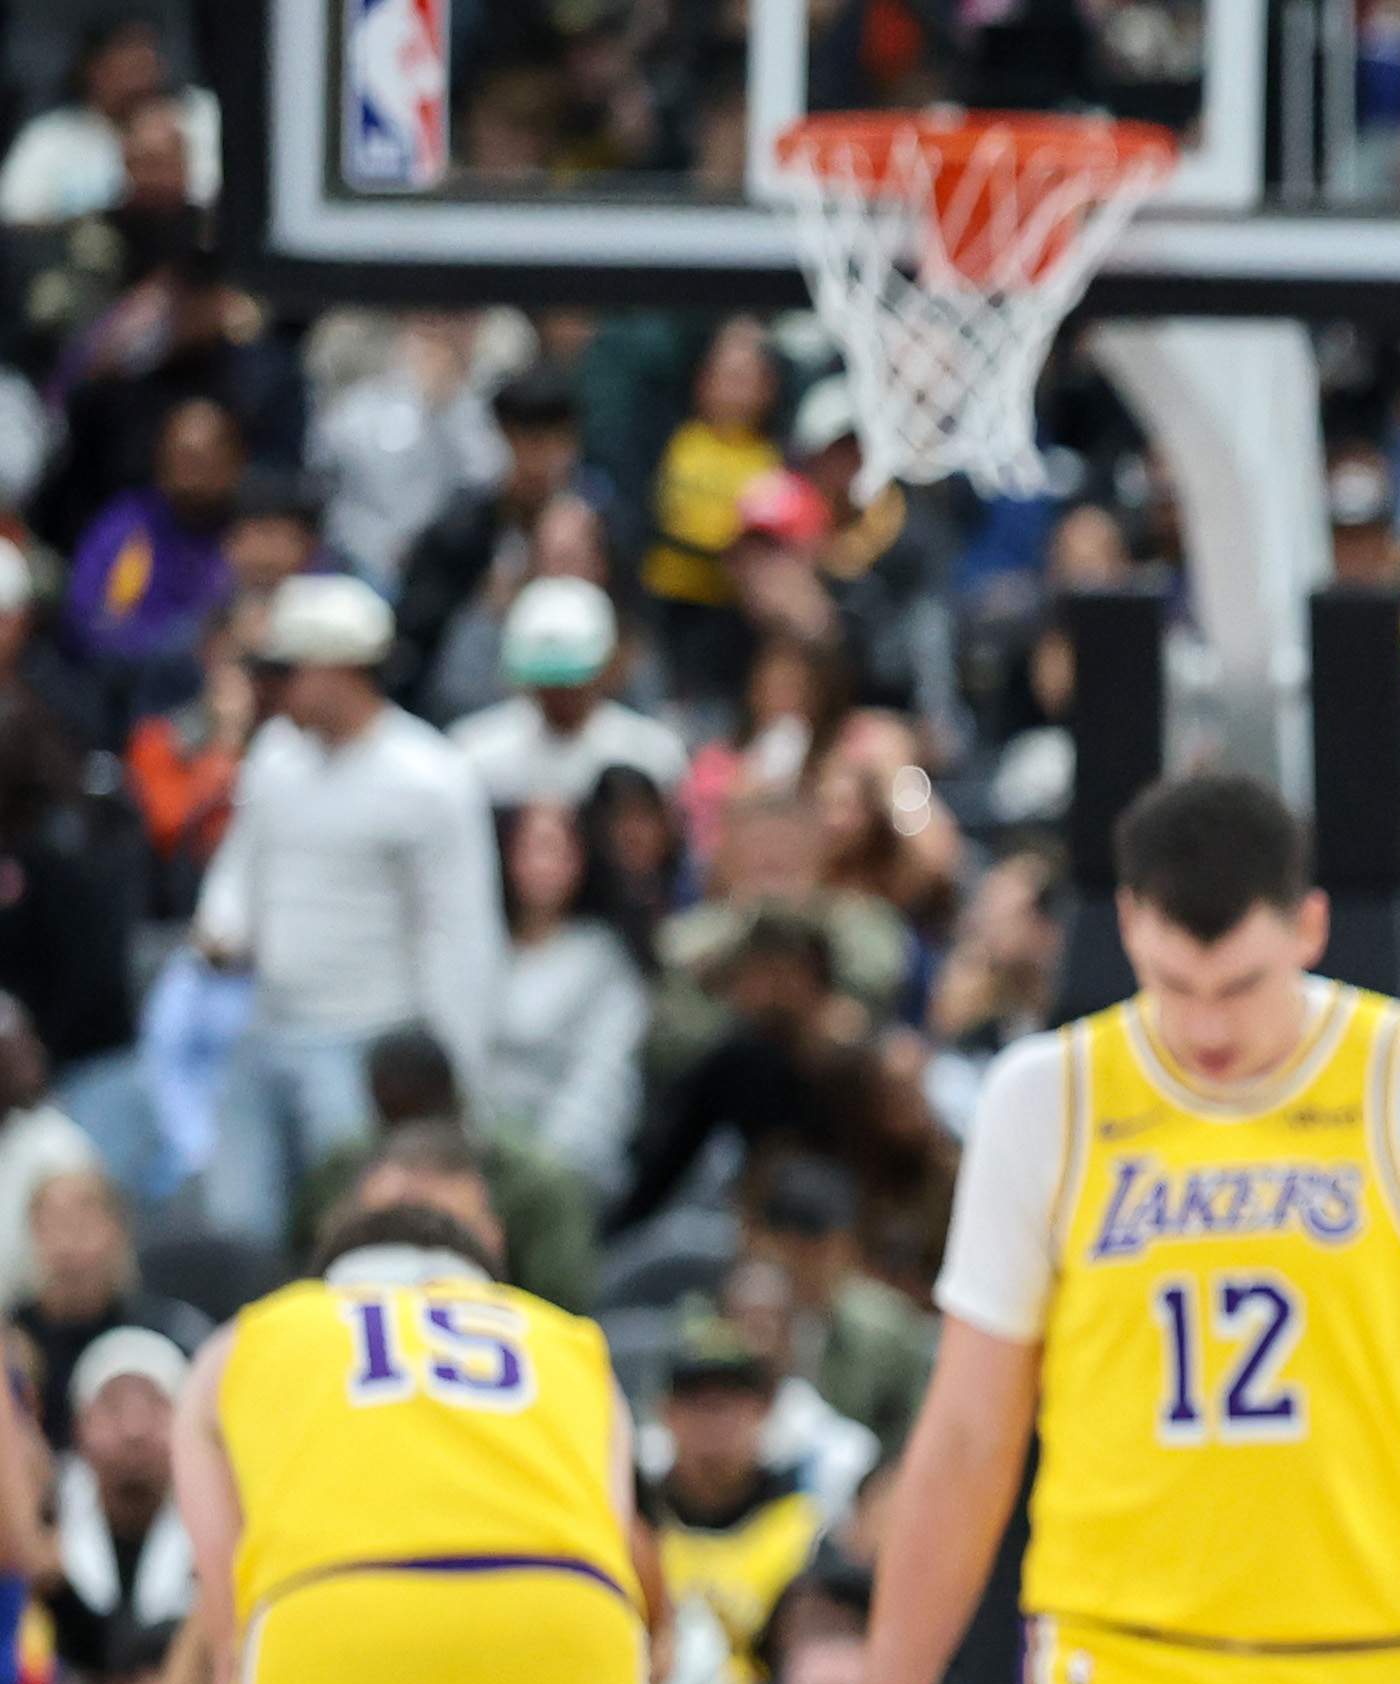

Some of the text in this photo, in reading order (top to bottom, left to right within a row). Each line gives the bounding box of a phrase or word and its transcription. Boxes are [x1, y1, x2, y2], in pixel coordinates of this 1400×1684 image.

[1092, 1156, 1363, 1260] LAKERS
[346, 1294, 533, 1406] 15
[1157, 1278, 1303, 1438] 12
